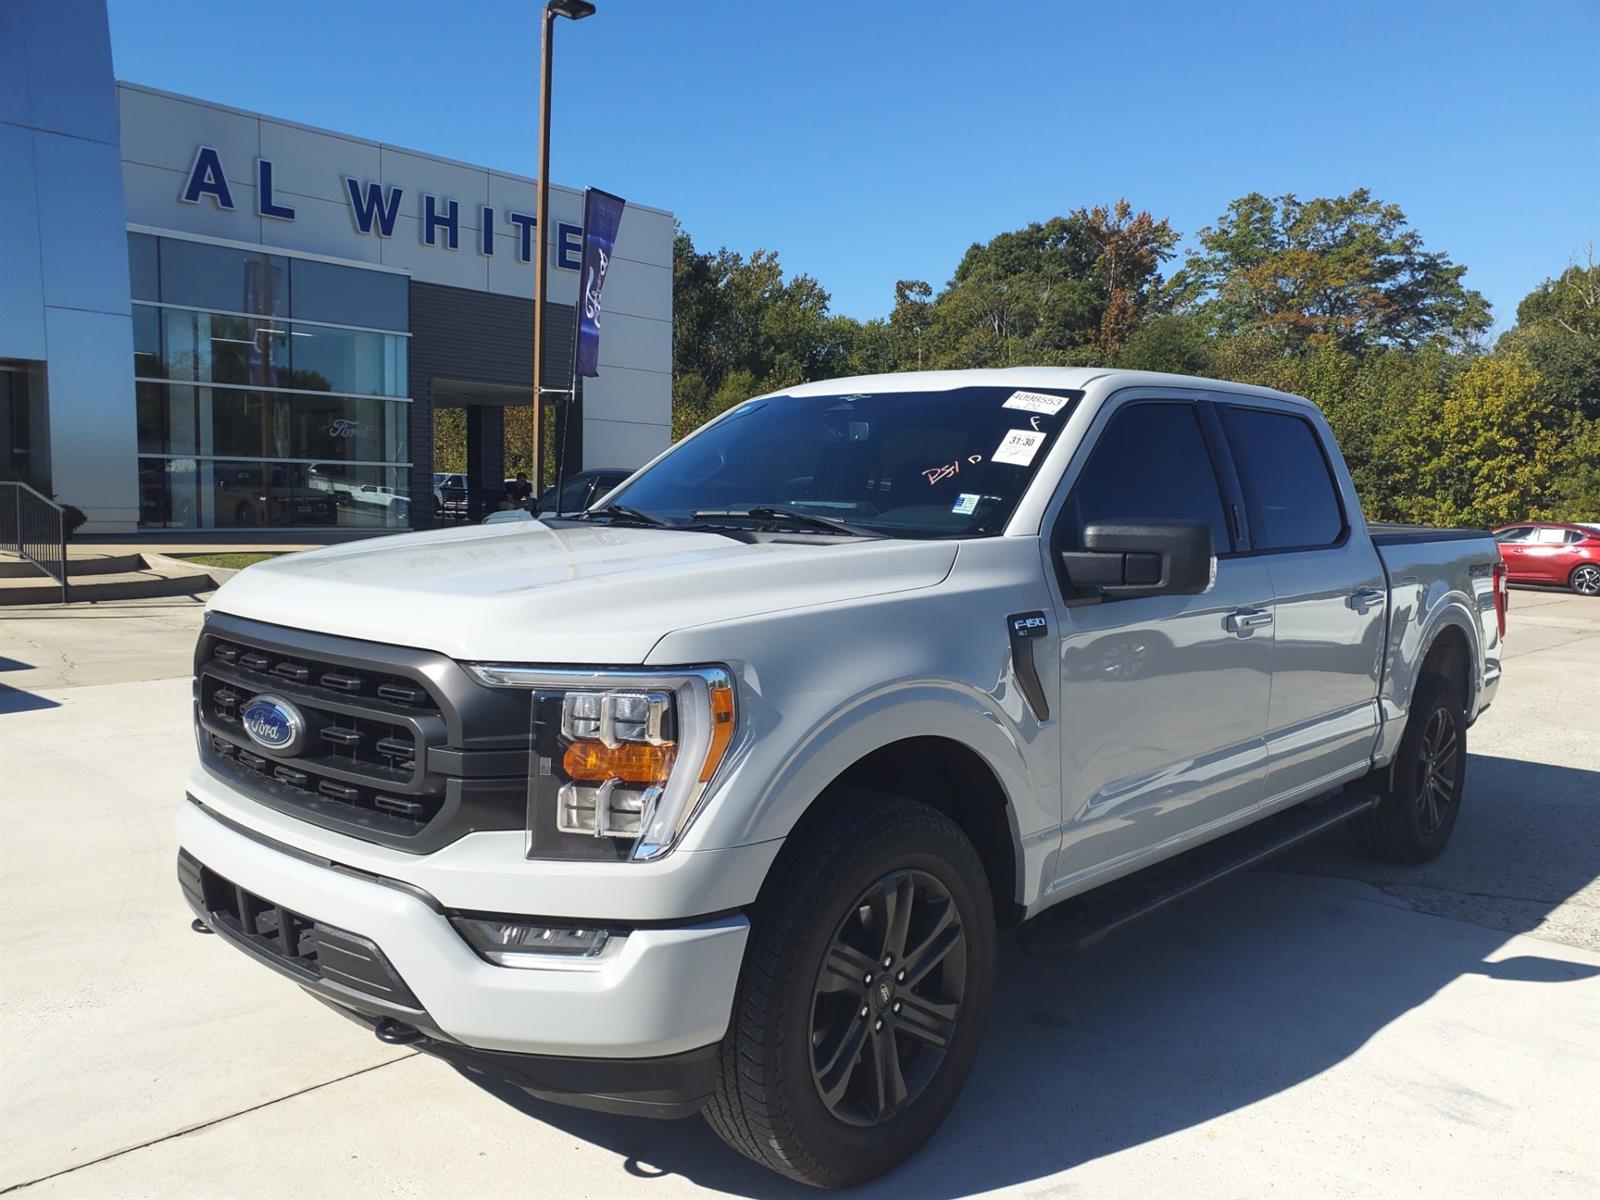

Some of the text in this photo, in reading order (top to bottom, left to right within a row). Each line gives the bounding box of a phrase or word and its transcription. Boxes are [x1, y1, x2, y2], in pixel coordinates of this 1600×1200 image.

[182, 146, 583, 272] AL WHITE
[585, 248, 610, 329] Fod
[1009, 436, 1036, 447] 31:30
[1014, 618, 1046, 629] F-150
[251, 710, 280, 740] Ford
